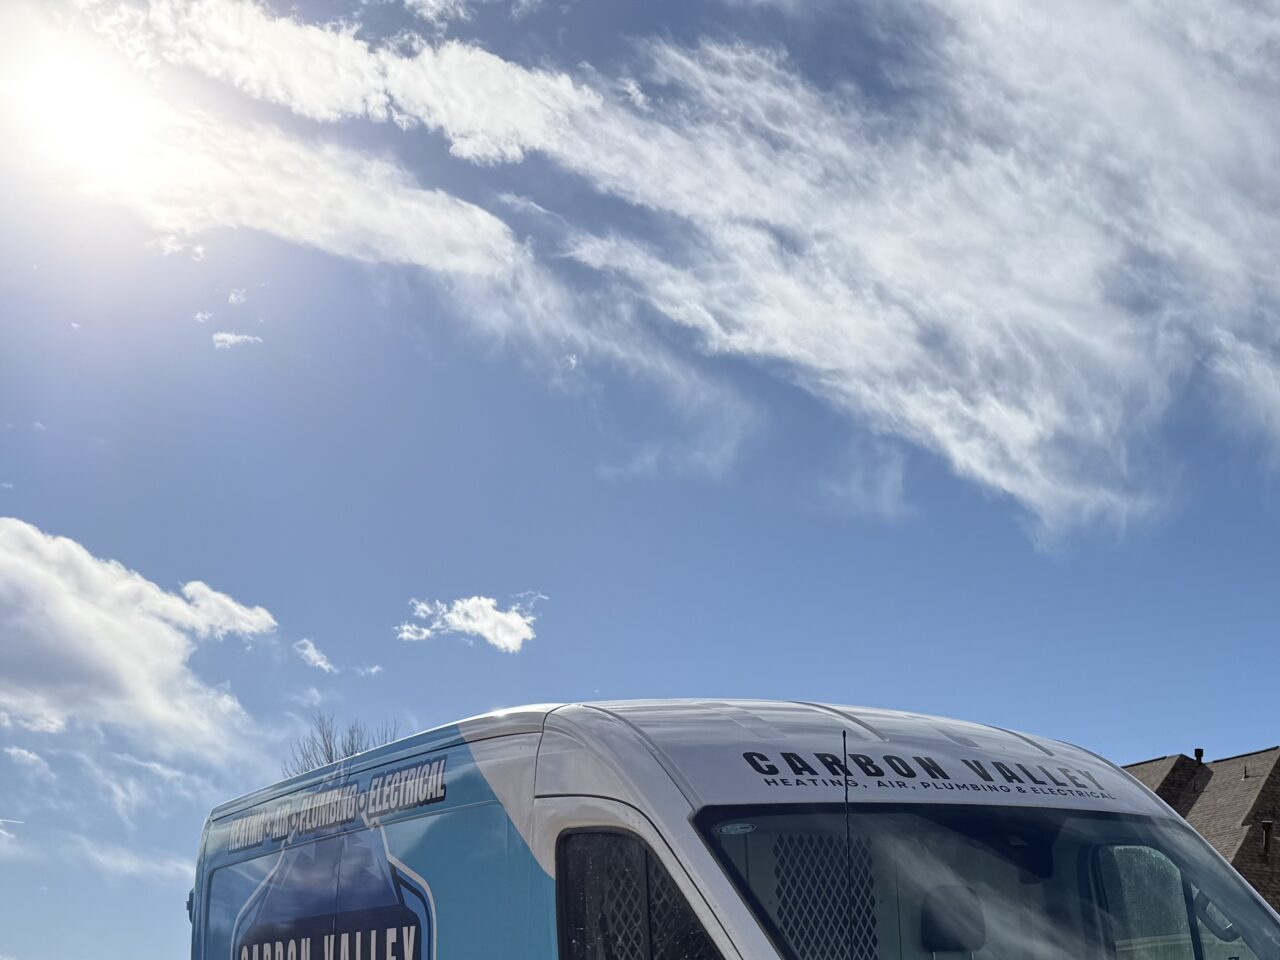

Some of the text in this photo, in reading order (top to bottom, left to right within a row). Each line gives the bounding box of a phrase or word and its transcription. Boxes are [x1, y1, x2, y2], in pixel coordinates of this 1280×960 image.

[743, 752, 1105, 790] CARBON VALLEY
[764, 778, 1117, 800] HEATING, AIR, PLUMBING & ELECTRICAL
[272, 803, 291, 838] AIR
[299, 784, 359, 832] PLUMBING
[367, 759, 446, 814] ELECTRICAL
